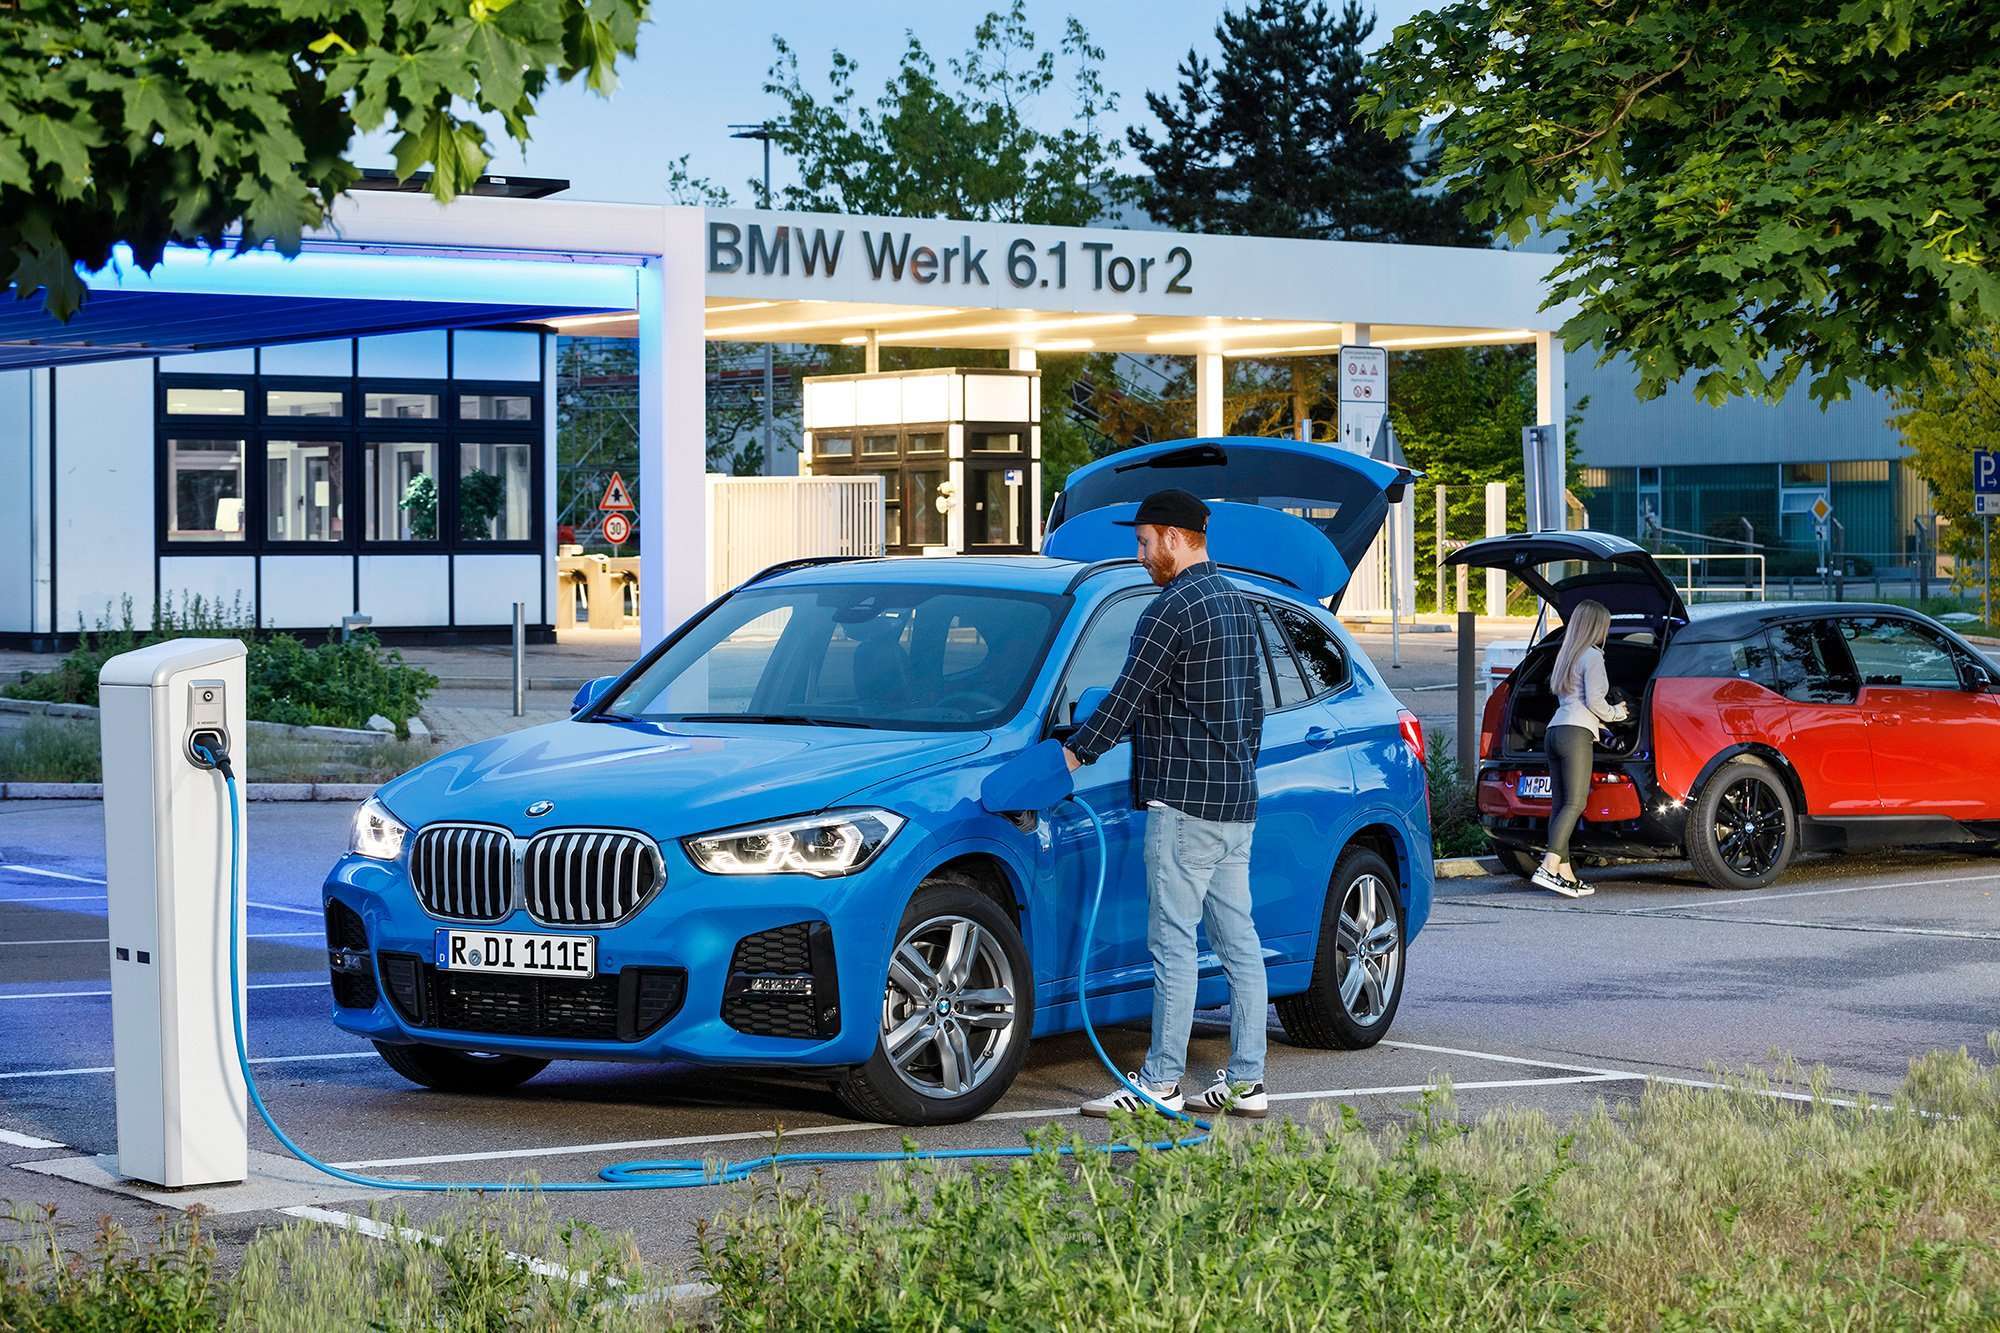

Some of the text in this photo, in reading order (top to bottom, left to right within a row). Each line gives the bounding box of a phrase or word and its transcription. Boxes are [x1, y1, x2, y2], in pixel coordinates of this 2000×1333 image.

[708, 222, 1193, 294] BMW Werk 6.1 Tor 2
[1980, 455, 1996, 487] P
[609, 522, 622, 535] 30
[1525, 779, 1533, 792] M
[439, 953, 446, 962] D
[451, 936, 589, 972] R DI 111E
